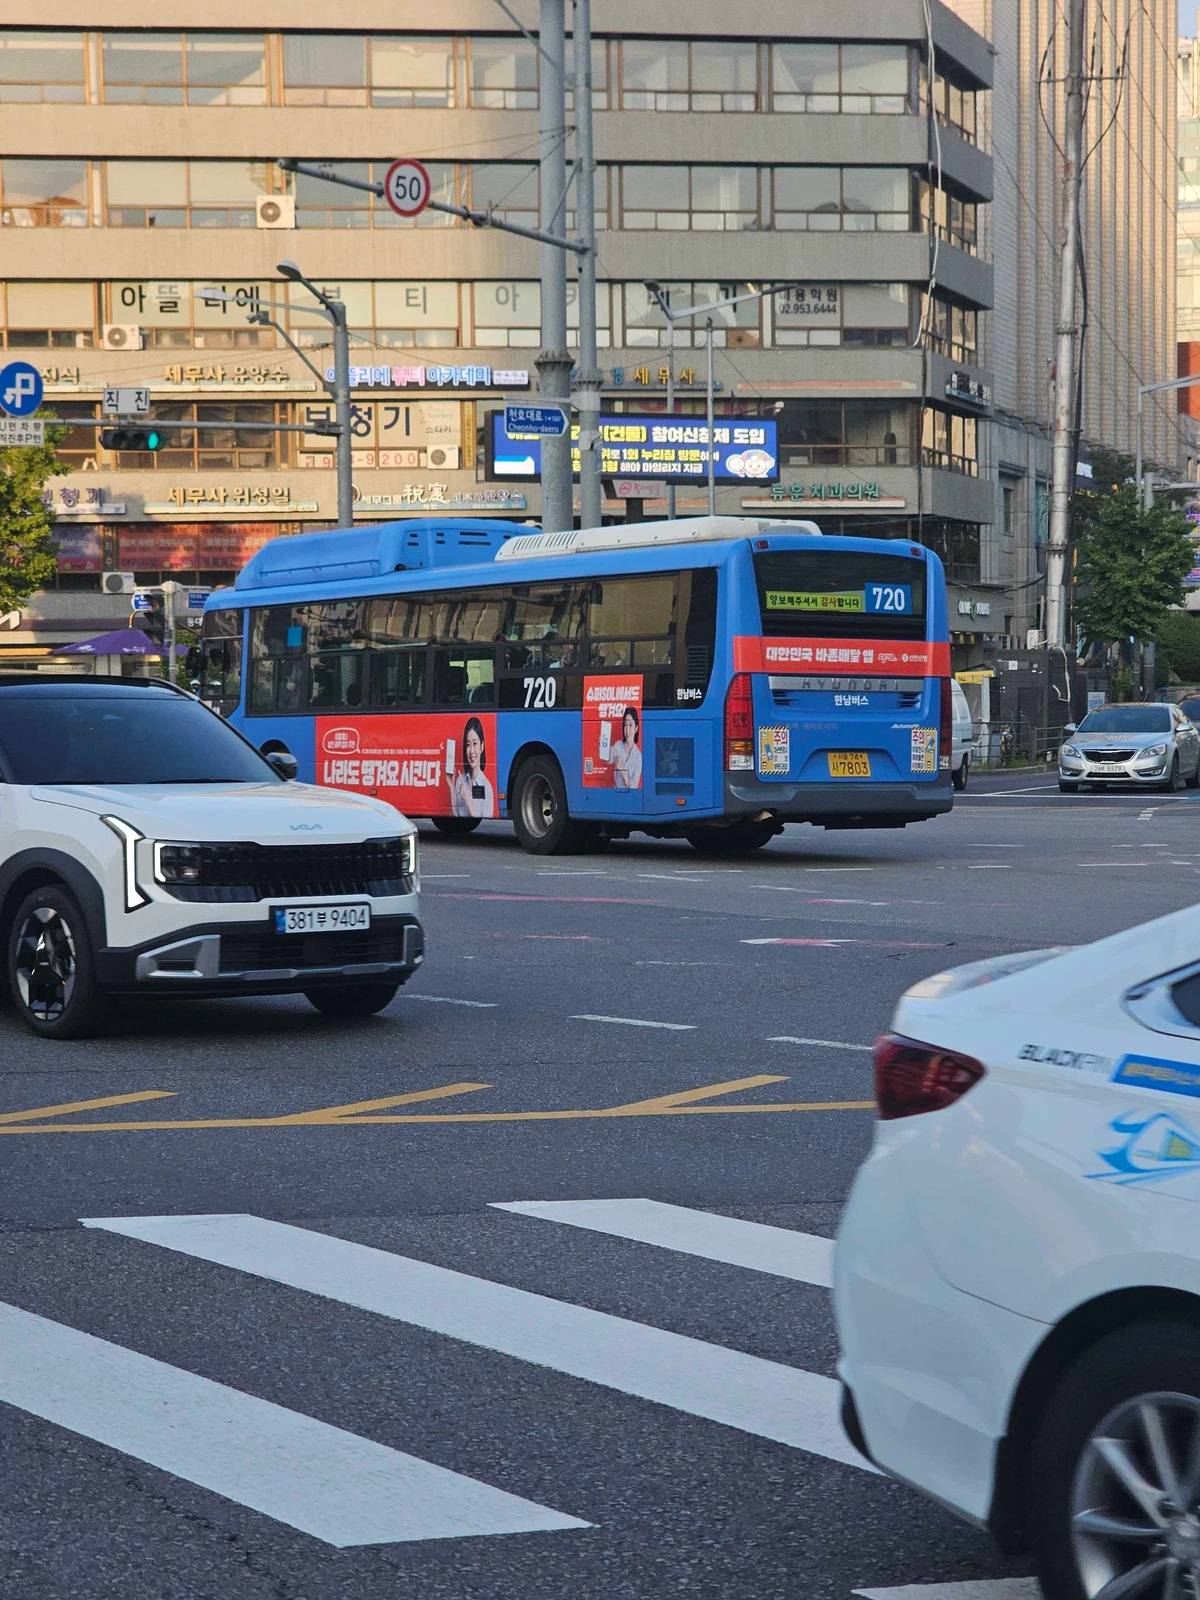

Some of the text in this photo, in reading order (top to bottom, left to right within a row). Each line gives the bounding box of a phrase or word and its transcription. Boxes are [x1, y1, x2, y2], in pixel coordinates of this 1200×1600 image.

[395, 175, 421, 201] 50
[779, 303, 837, 314] 02.953.6444
[165, 364, 227, 385] 세무사
[391, 366, 425, 386] 뷰티
[427, 366, 492, 386] 아카데미
[634, 366, 694, 385] 세무사
[105, 390, 148, 412] 직진
[508, 408, 543, 423] 천호대로
[426, 425, 452, 434] 스타키
[508, 422, 559, 433] Cheonho-daero
[652, 426, 730, 444] 참여신청제
[733, 428, 765, 445] 도입
[641, 448, 675, 461] 누리집
[643, 463, 681, 473] 마일리지
[167, 486, 291, 507] 세무사 위성일
[362, 494, 402, 505] 세무그룹
[810, 483, 880, 501] 치과의원
[769, 594, 860, 609] 양보해주셔서 감사합니다
[872, 587, 905, 611] 720
[765, 646, 813, 662] 대한민국
[862, 649, 874, 664] 앱
[523, 676, 557, 709] 720
[801, 678, 899, 691] HYUNDAI
[676, 688, 702, 700] 한남버스
[833, 694, 869, 707] 한남버스
[773, 730, 788, 745] 주의
[912, 730, 925, 744] 주의
[323, 759, 441, 787] 나라도 땡겨요 시킨다
[330, 908, 366, 928] 9404
